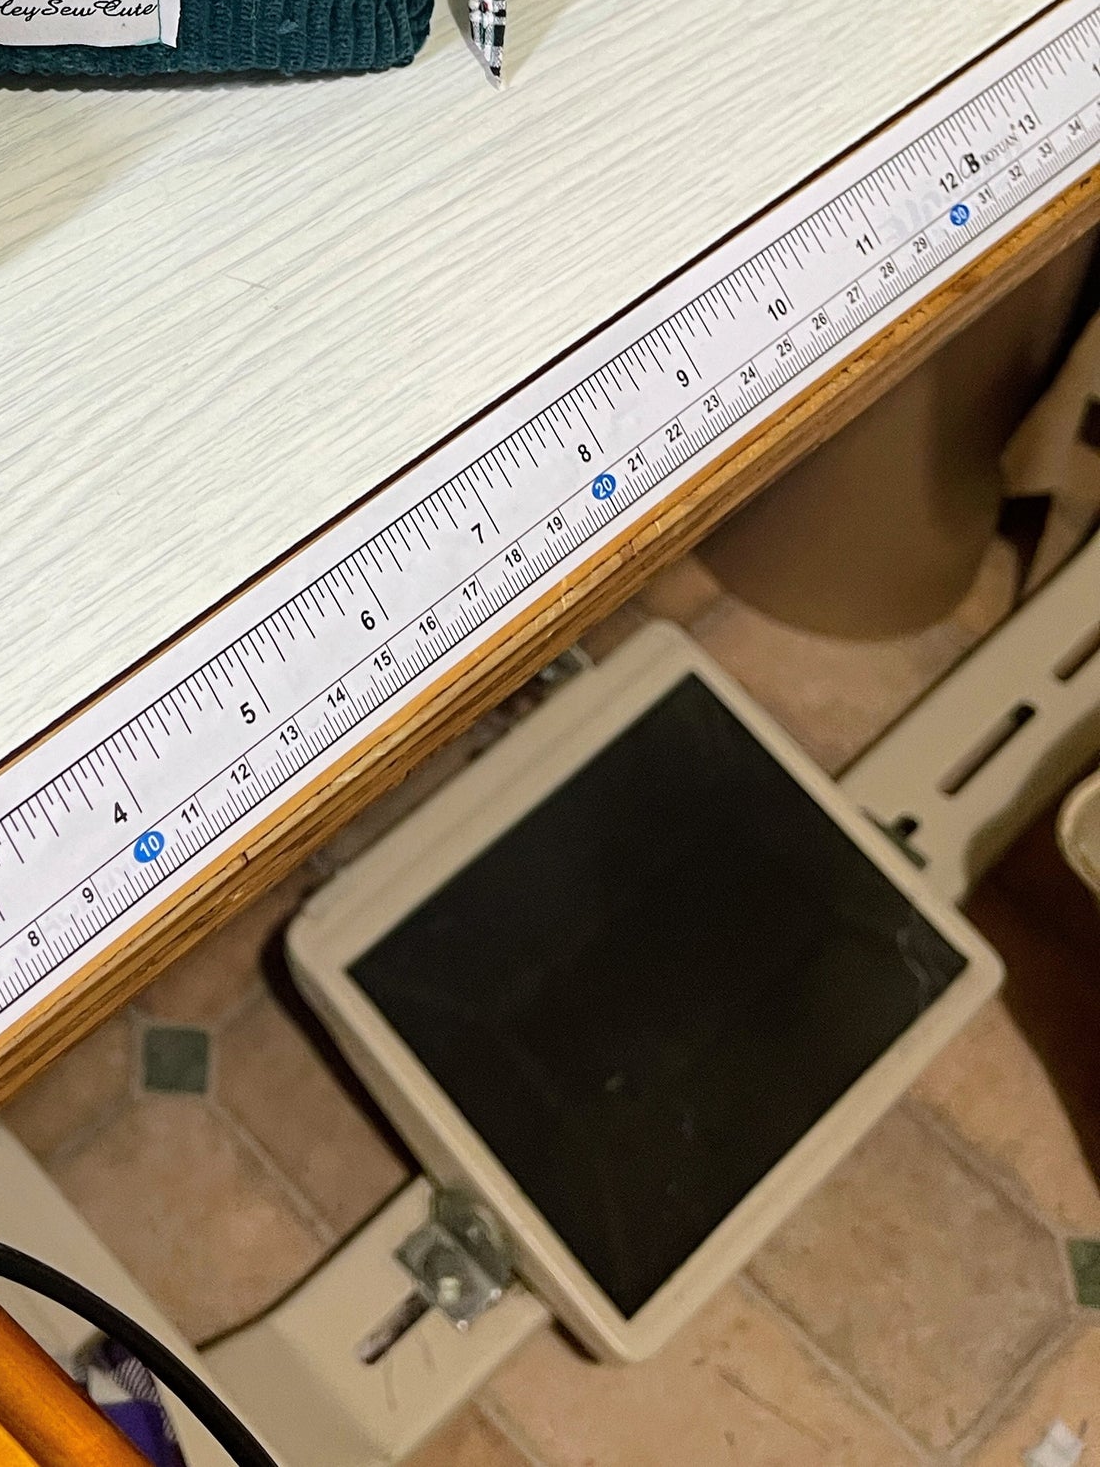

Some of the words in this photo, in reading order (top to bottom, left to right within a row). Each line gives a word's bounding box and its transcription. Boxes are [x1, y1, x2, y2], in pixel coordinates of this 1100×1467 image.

[27, 929, 41, 947] 8
[82, 887, 95, 903] 9
[138, 834, 161, 857] 10
[182, 803, 199, 823] 11
[231, 764, 250, 784] 12
[280, 725, 298, 745] 13
[327, 687, 345, 707] 14
[374, 651, 391, 671] 15
[419, 616, 436, 635] 16
[463, 581, 477, 600] 17
[505, 549, 521, 567] 18
[547, 517, 562, 534] 19
[594, 476, 613, 496] 20
[628, 453, 643, 472] 21
[666, 424, 682, 442] 22
[703, 395, 719, 413] 23
[740, 366, 756, 385] 24
[777, 339, 792, 357] 25
[812, 313, 827, 330] 26
[847, 286, 860, 304] 27
[880, 262, 894, 279] 28
[913, 237, 927, 254] 29
[952, 205, 969, 222] 30
[978, 189, 992, 204] 31
[1008, 166, 1022, 181] 32
[115, 802, 127, 823] 4
[240, 702, 255, 724] 5
[361, 611, 375, 630] 6
[471, 523, 483, 543] 7
[578, 444, 591, 462] 8
[677, 370, 689, 387] 9
[768, 299, 787, 320] 10
[856, 235, 873, 255] 11
[940, 173, 958, 193] 12
[1019, 114, 1035, 134] 13
